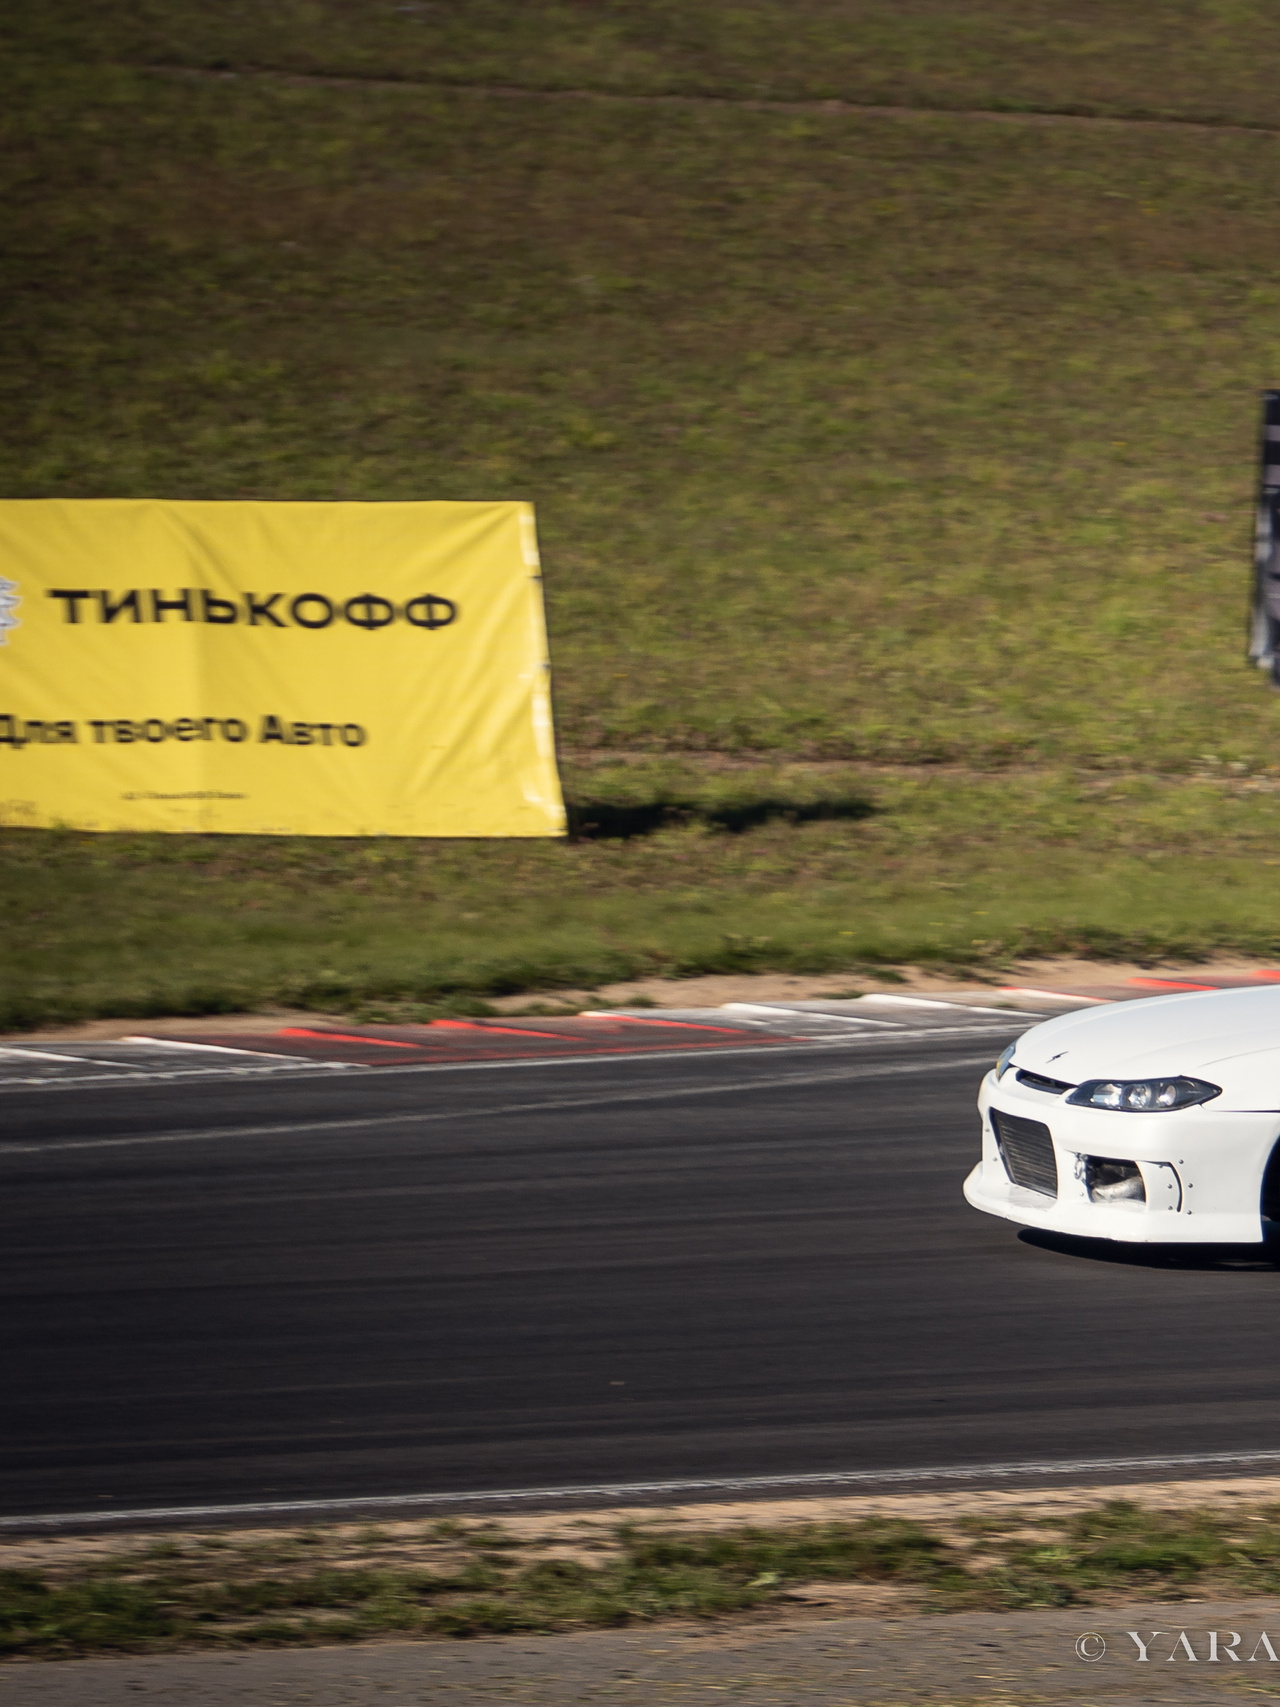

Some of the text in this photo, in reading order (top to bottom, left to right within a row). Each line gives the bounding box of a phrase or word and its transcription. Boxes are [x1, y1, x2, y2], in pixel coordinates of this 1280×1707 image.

[48, 588, 458, 631] ТИНЬКОФФ
[86, 716, 249, 744] твоего
[258, 715, 369, 747] Авто
